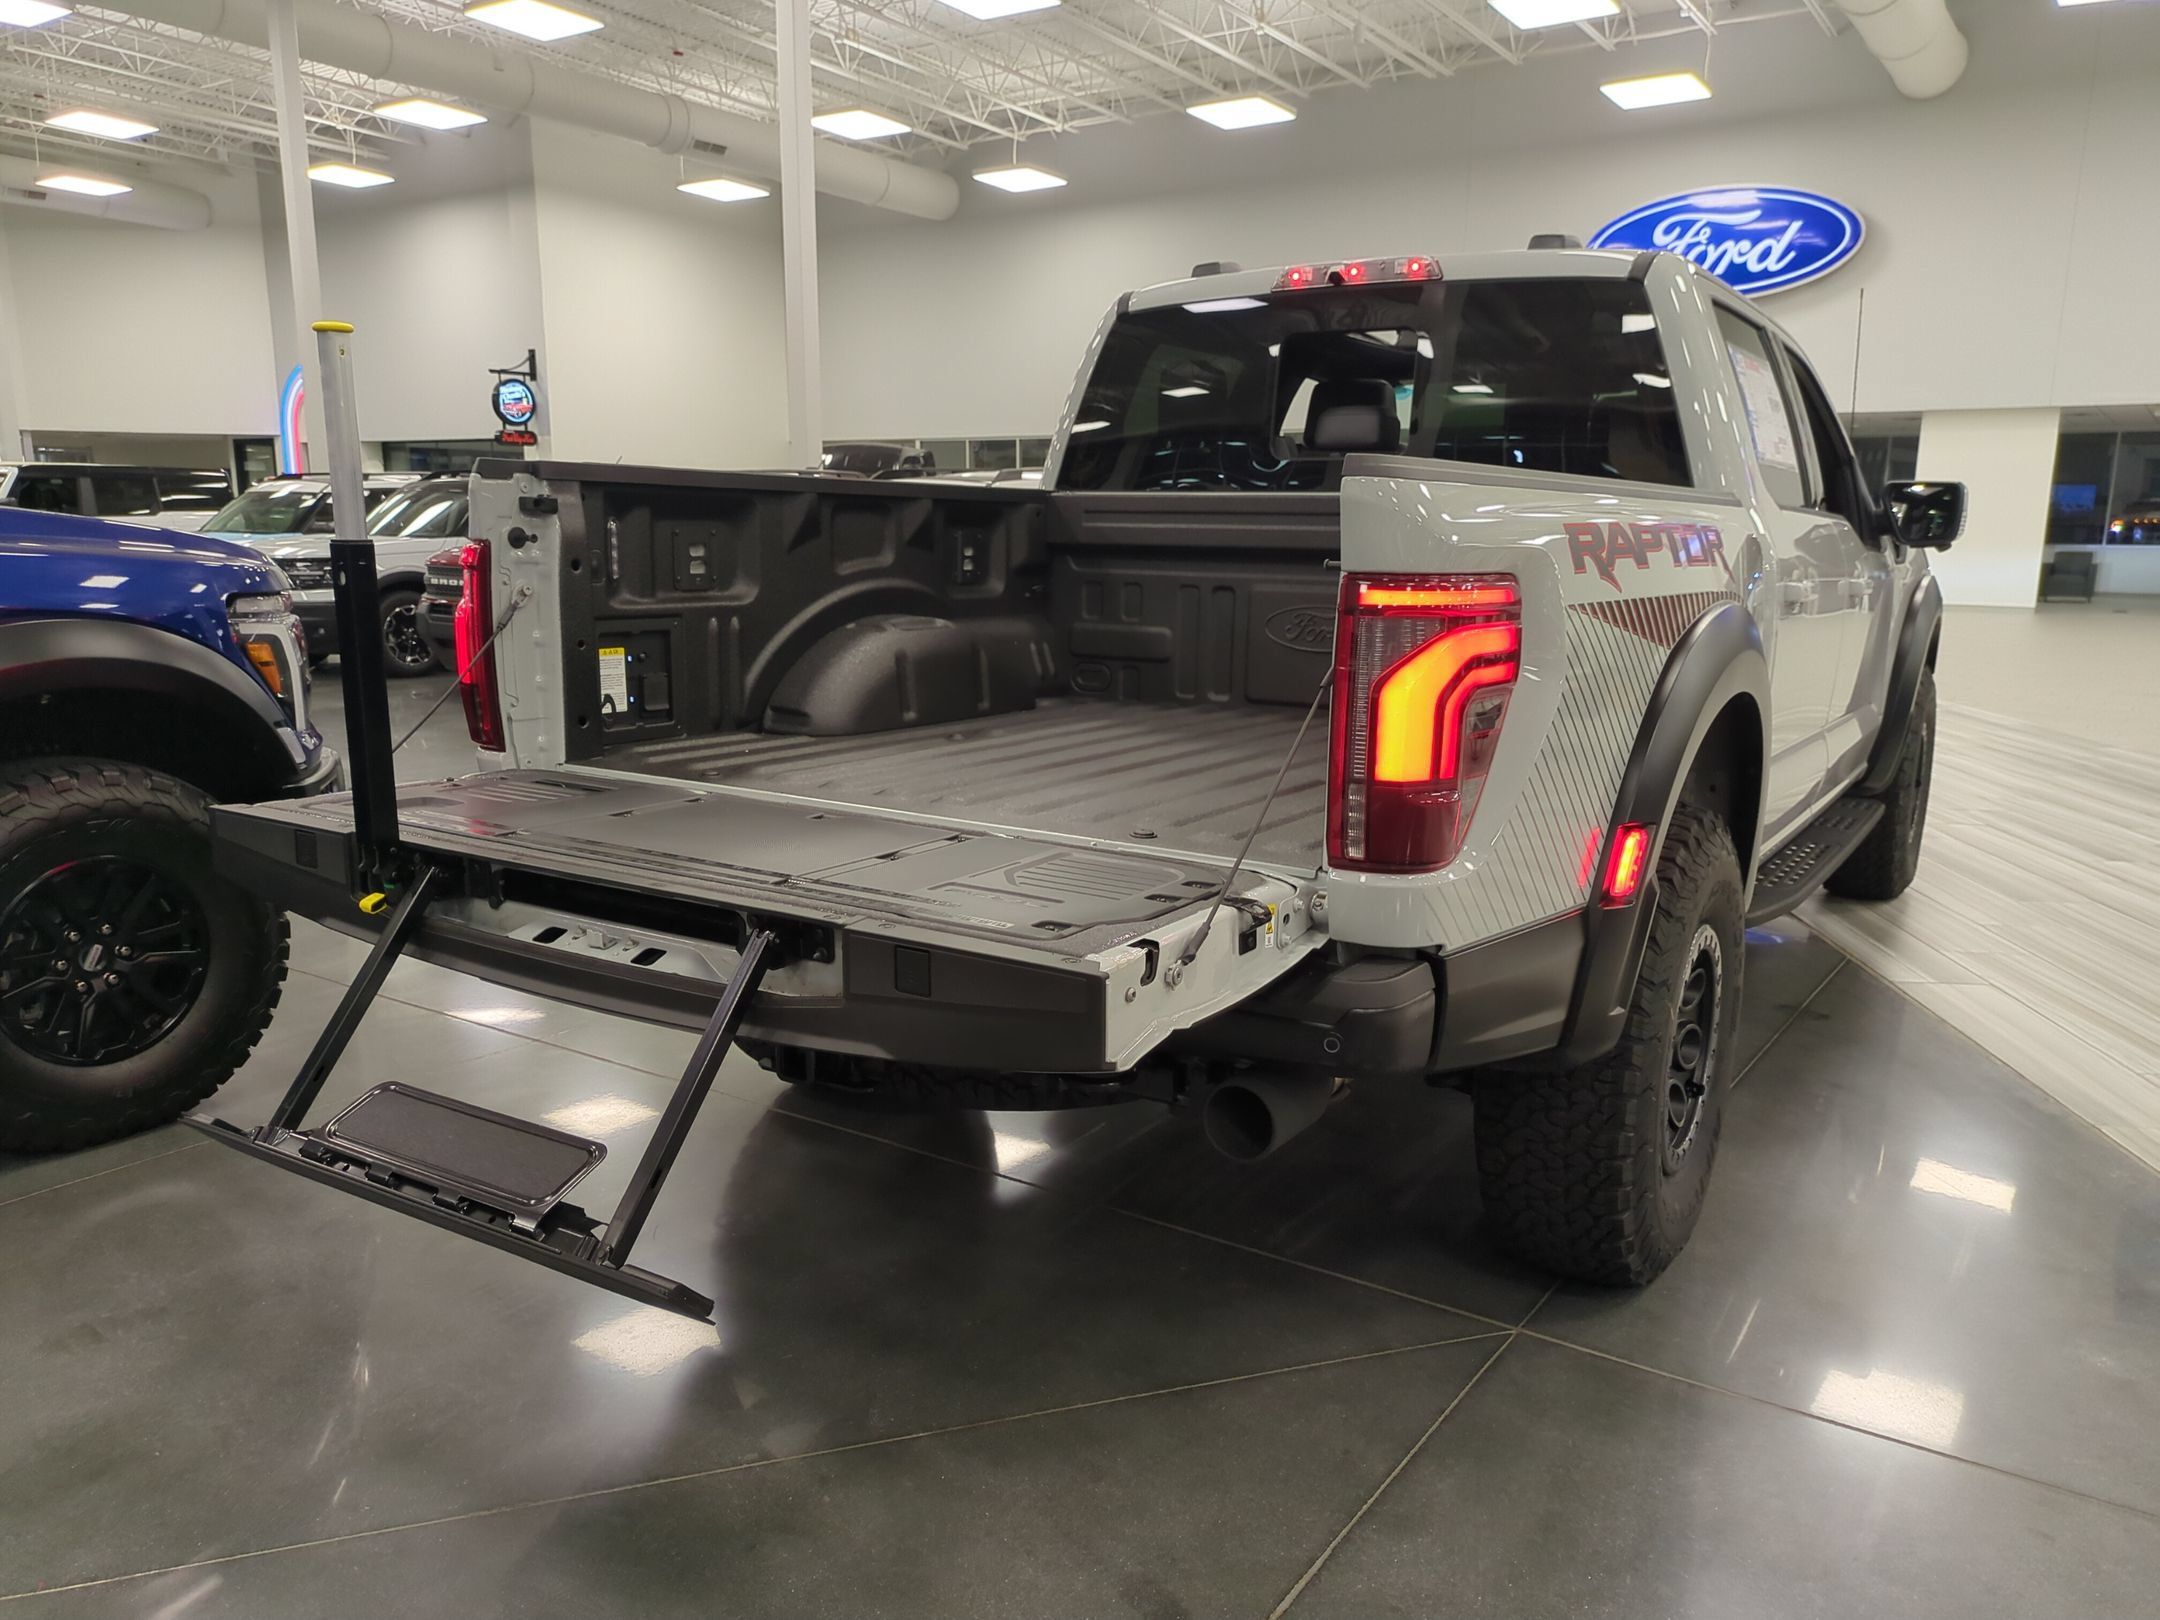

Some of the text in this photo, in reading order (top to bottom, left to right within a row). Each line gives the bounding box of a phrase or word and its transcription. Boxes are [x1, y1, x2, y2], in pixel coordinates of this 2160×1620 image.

[1652, 209, 1803, 275] Ford
[1563, 522, 1736, 594] RAPTOR
[1284, 611, 1335, 642] For
